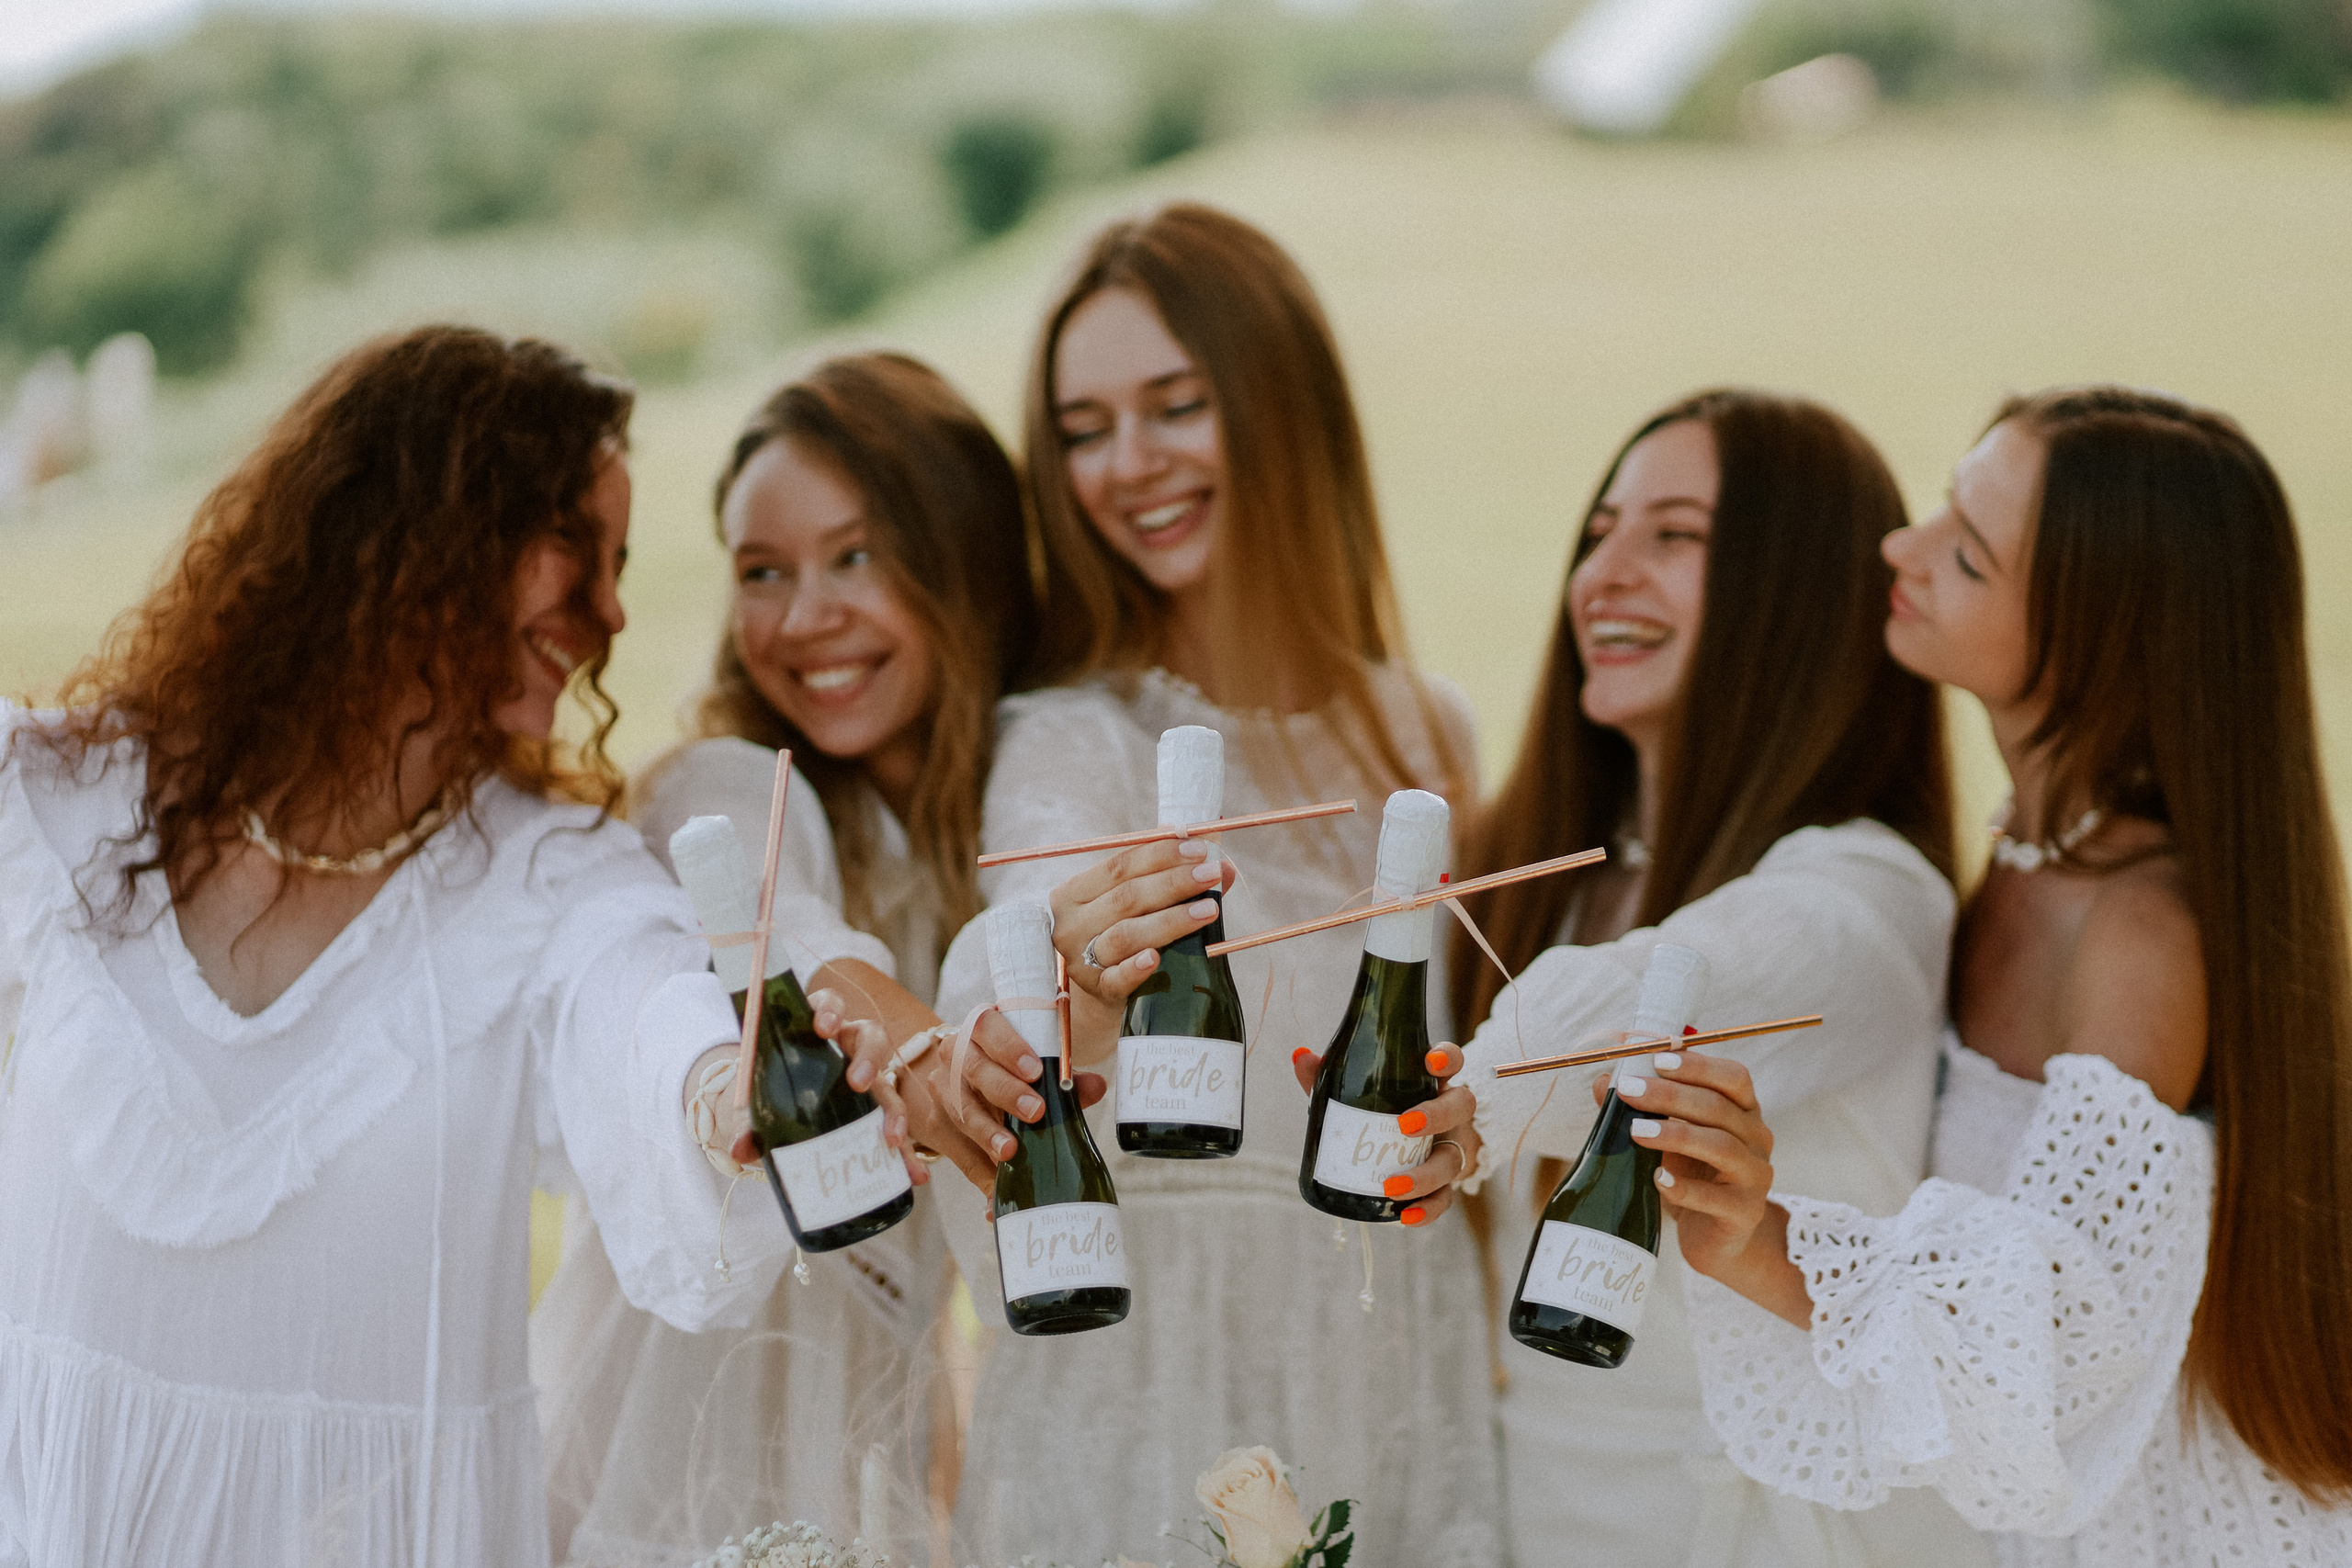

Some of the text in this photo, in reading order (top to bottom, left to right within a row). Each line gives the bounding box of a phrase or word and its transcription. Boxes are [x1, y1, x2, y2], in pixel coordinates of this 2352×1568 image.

[1146, 1043, 1195, 1055] the best
[1129, 1048, 1225, 1098] bride
[1145, 1095, 1187, 1110] team
[1379, 1121, 1399, 1134] the
[815, 1125, 897, 1198] brid
[1041, 1211, 1091, 1225] the best
[1026, 1216, 1119, 1269] bride
[1587, 1237, 1634, 1262] the best
[1048, 1263, 1092, 1278] team
[1557, 1236, 1645, 1304] bride
[1574, 1286, 1614, 1312] team
